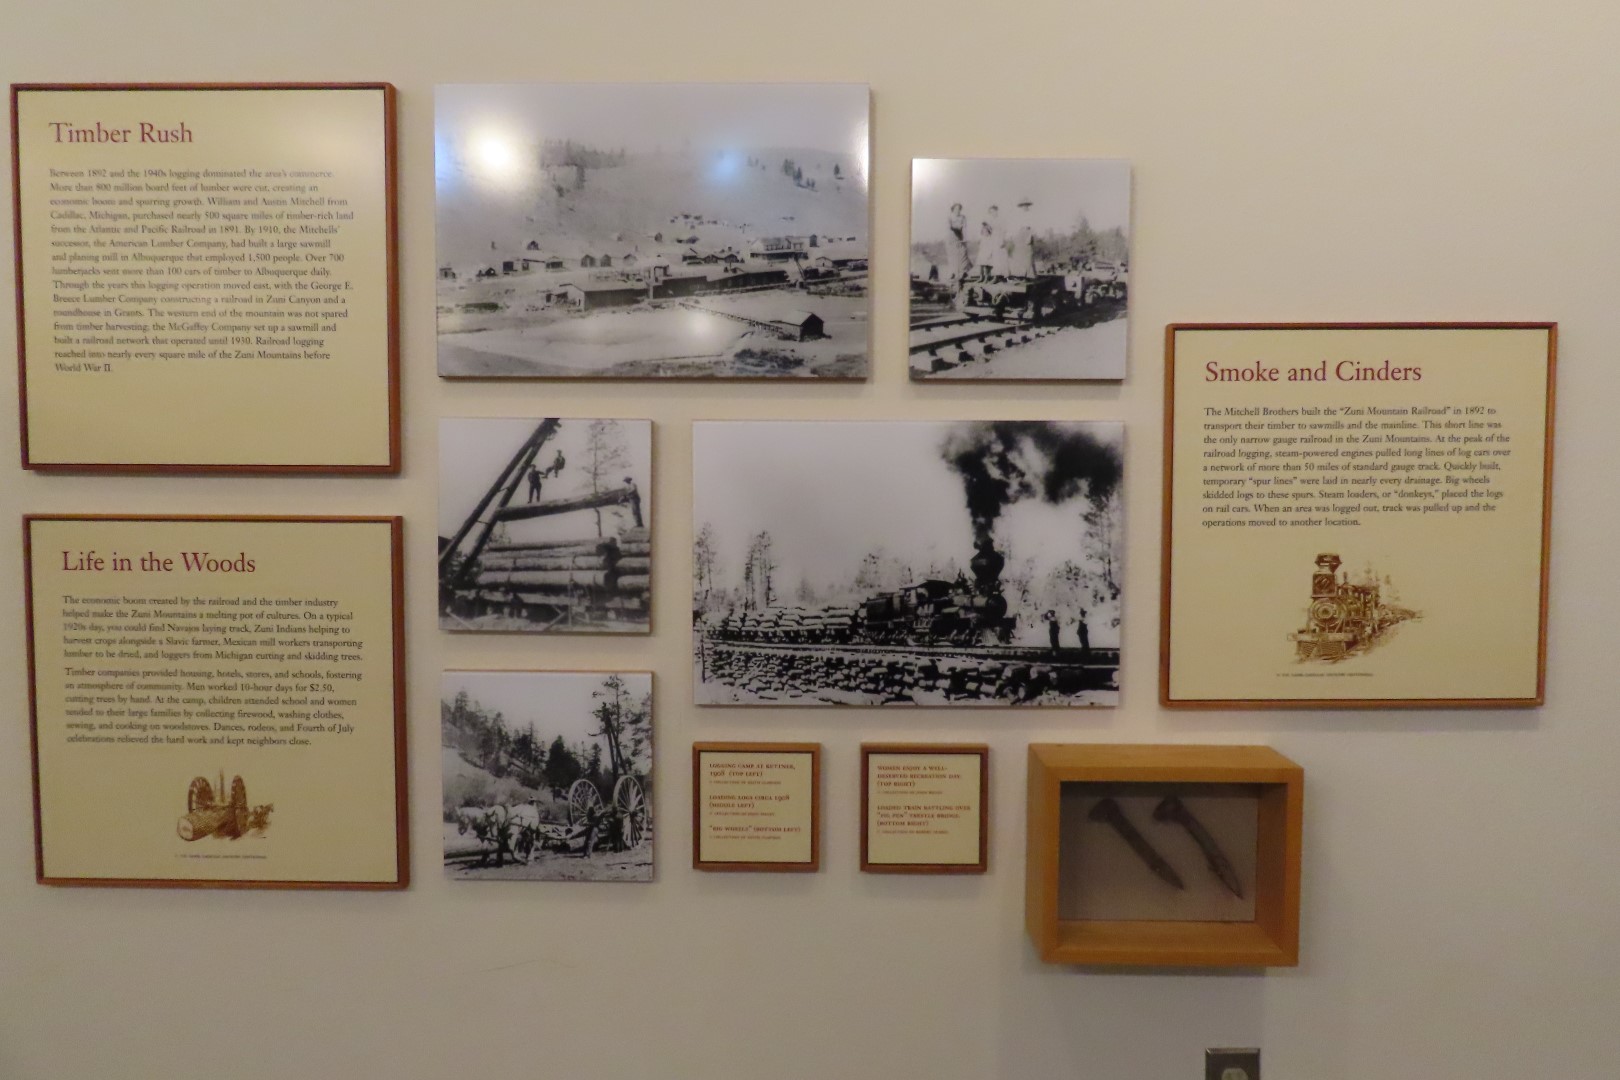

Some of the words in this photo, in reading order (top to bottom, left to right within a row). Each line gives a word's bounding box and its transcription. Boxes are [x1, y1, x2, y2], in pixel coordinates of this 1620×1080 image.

[49, 122, 132, 143] Timber
[139, 122, 193, 143] Rush
[51, 224, 71, 233] from
[73, 224, 86, 233] the
[88, 225, 121, 233] Atlantic
[123, 225, 138, 233] and
[141, 225, 168, 233] Pacific
[170, 225, 205, 233] Railroad
[283, 225, 296, 234] the
[55, 349, 85, 358] reached
[88, 350, 105, 358] into
[107, 350, 132, 360] nearly
[134, 352, 156, 360] every
[158, 352, 185, 360] square
[187, 350, 205, 358] mile
[218, 350, 232, 358] the
[234, 350, 254, 359] Zuni
[256, 350, 301, 359] Mountains
[303, 350, 330, 359] before
[55, 363, 81, 371] World
[84, 363, 101, 371] War
[1205, 361, 1279, 382] Smoke
[1287, 360, 1327, 382] and
[1335, 360, 1422, 381] Cinders
[1204, 407, 1221, 415] The
[1224, 407, 1259, 415] Mitchell
[1262, 407, 1298, 415] Brothers
[1301, 407, 1320, 415] built
[1323, 406, 1337, 415] the
[1366, 406, 1408, 415] Mountain
[1465, 406, 1484, 414] 1892
[1204, 421, 1242, 431] transport
[1244, 421, 1264, 429] their
[1266, 420, 1295, 429] timber
[1297, 421, 1306, 429] to
[1308, 420, 1344, 429] sawmills
[1346, 420, 1362, 429] and
[1364, 420, 1378, 429] the
[1422, 420, 1441, 428] This
[1444, 420, 1465, 428] short
[1468, 420, 1484, 428] line
[1204, 435, 1216, 443] the
[1219, 434, 1237, 445] only
[1272, 437, 1297, 445] gauge
[1299, 434, 1332, 443] railroad
[1335, 435, 1343, 443] in
[1346, 434, 1359, 442] the
[1362, 434, 1382, 442] Zuni
[1434, 434, 1445, 442] At
[1447, 434, 1461, 442] the
[1463, 434, 1482, 444] peak
[1485, 434, 1493, 442] of
[1496, 434, 1509, 442] the
[1203, 449, 1235, 457] railroad
[1274, 448, 1338, 459] steam-powered
[1340, 449, 1372, 459] engines
[1375, 448, 1401, 459] pulled
[1403, 448, 1422, 459] long
[1424, 448, 1444, 456] lines
[1446, 448, 1455, 456] of
[1458, 448, 1471, 458] log
[1210, 463, 1244, 471] network
[1246, 463, 1255, 471] of
[1282, 462, 1302, 471] than
[1304, 462, 1314, 471] 50
[1316, 462, 1338, 471] miles
[1341, 462, 1350, 470] of
[1352, 462, 1388, 470] standard
[1390, 464, 1415, 473] gauge
[1443, 462, 1476, 472] Quickly
[61, 551, 104, 572] Life
[112, 552, 132, 572] in
[140, 552, 174, 572] the
[181, 552, 256, 573] Woods
[64, 649, 92, 657] lumber
[143, 650, 158, 658] and
[160, 650, 190, 661] loggers
[192, 650, 212, 659] from
[214, 651, 253, 661] Michigan
[255, 652, 284, 662] cutting
[286, 651, 302, 660] and
[304, 652, 338, 662] skidding
[65, 668, 95, 676] Timber
[97, 668, 139, 679] companies
[142, 668, 177, 679] provided
[274, 670, 289, 678] and
[325, 670, 362, 681] fostering
